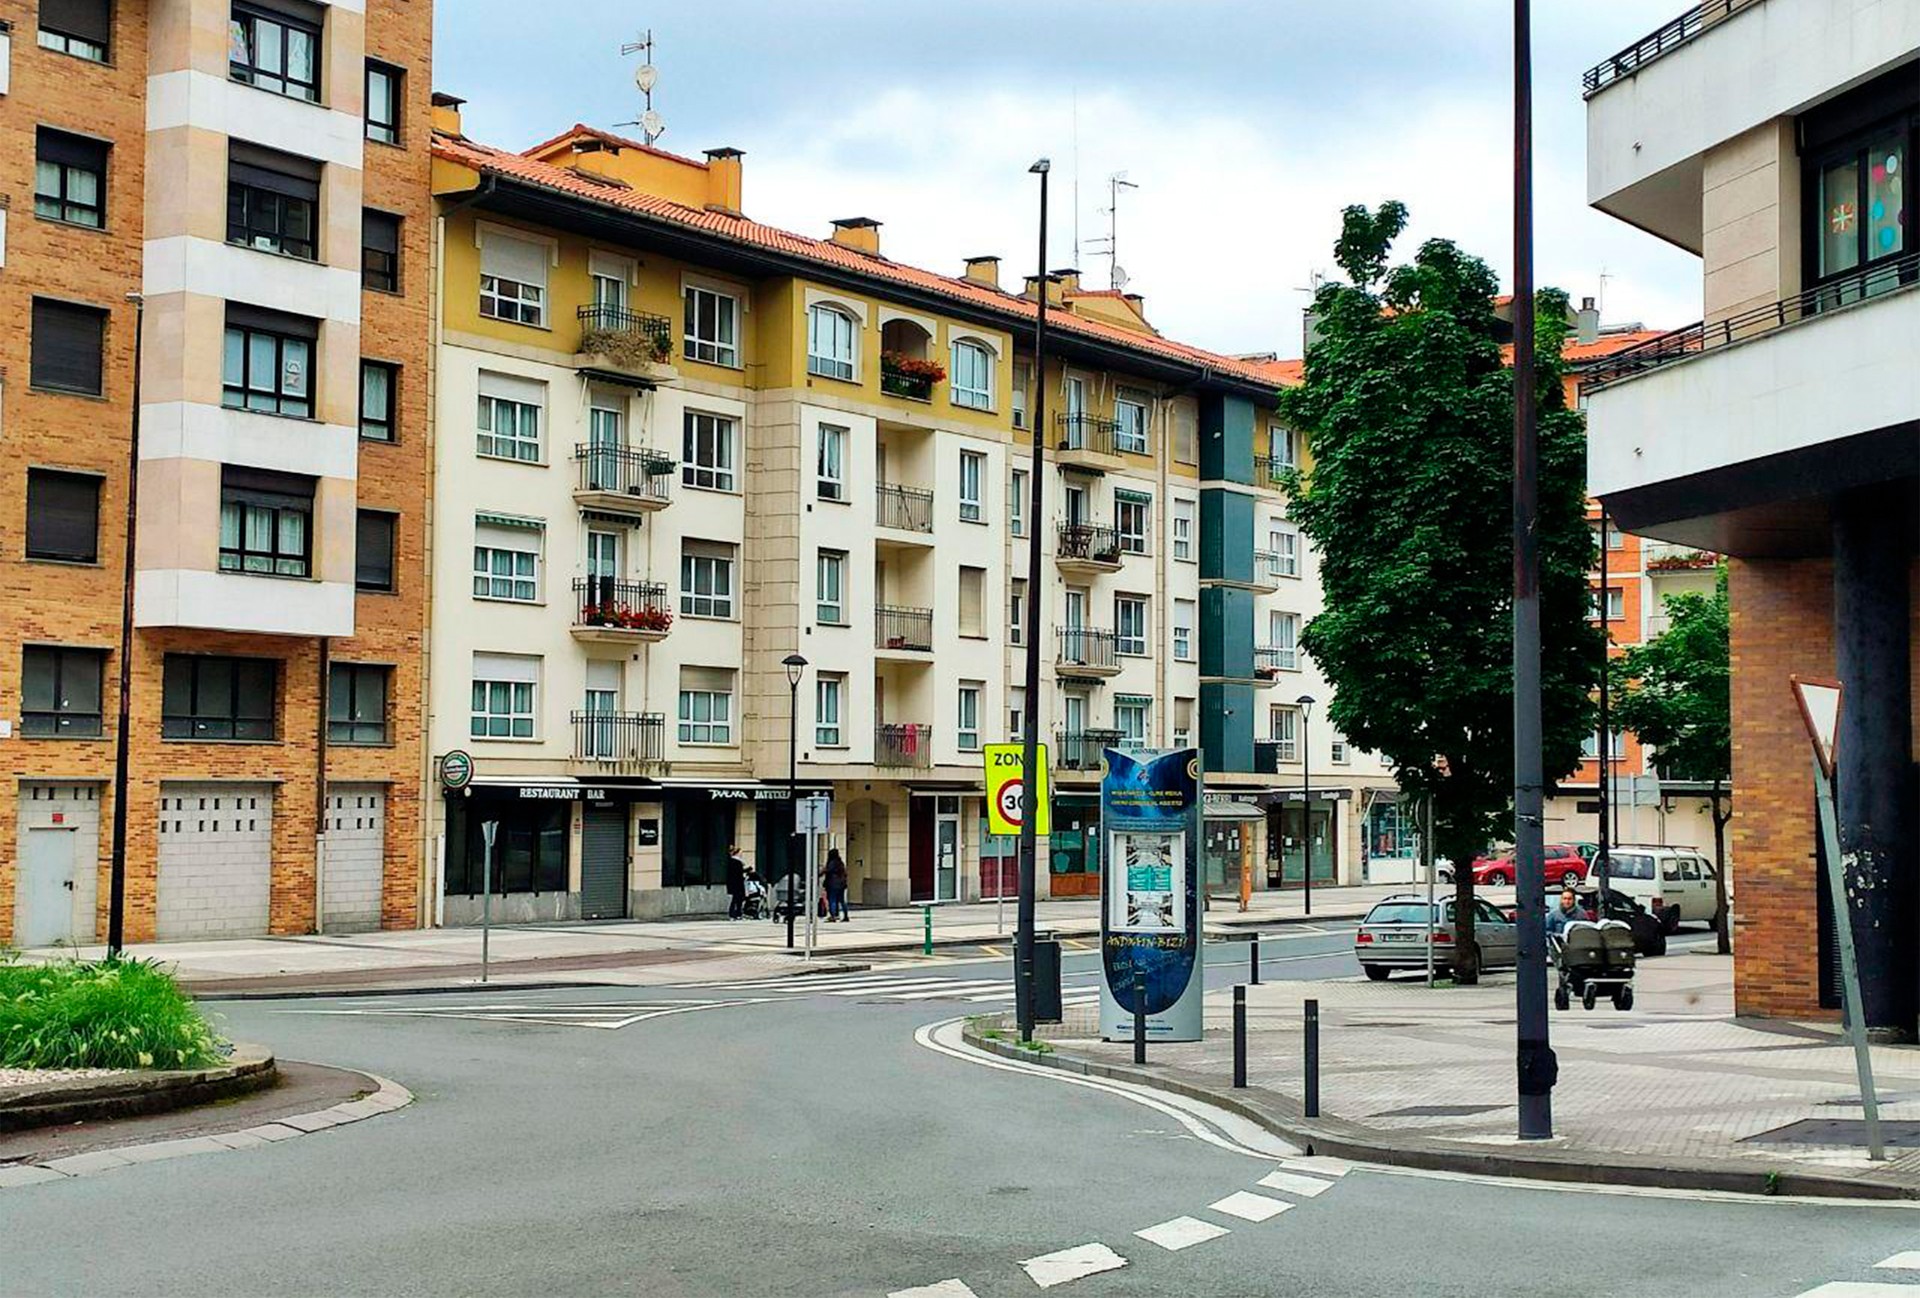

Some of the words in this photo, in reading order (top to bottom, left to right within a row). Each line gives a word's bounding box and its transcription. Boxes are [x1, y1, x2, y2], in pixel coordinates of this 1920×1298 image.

[994, 753, 1024, 766] ZON
[519, 787, 580, 799] RESTAURANT
[586, 789, 606, 800] BAR
